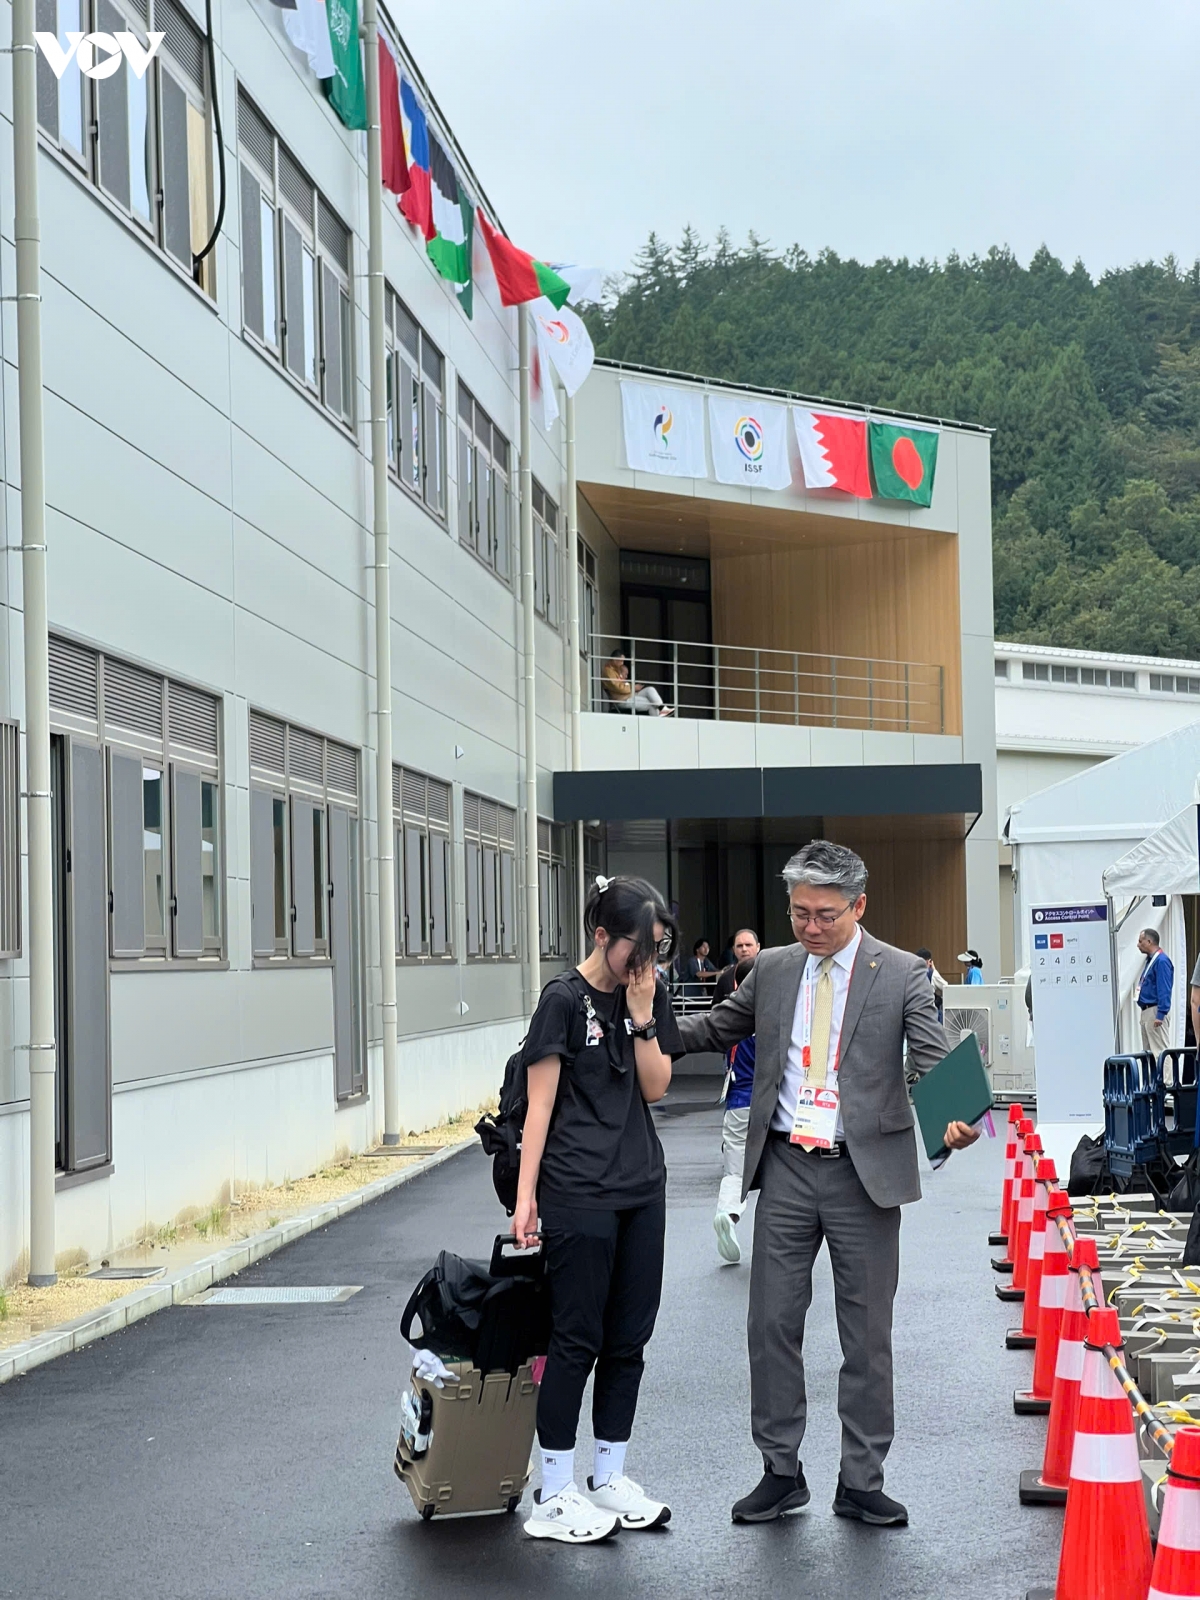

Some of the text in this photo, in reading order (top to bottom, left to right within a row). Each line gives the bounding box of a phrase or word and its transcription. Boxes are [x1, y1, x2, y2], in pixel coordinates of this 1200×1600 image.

[744, 463, 763, 474] ISSF
[1039, 955, 1092, 966] 2 4 5 6
[1056, 976, 1062, 984] F
[1070, 976, 1078, 984] A
[1086, 975, 1093, 983] P
[1102, 974, 1109, 983] B
